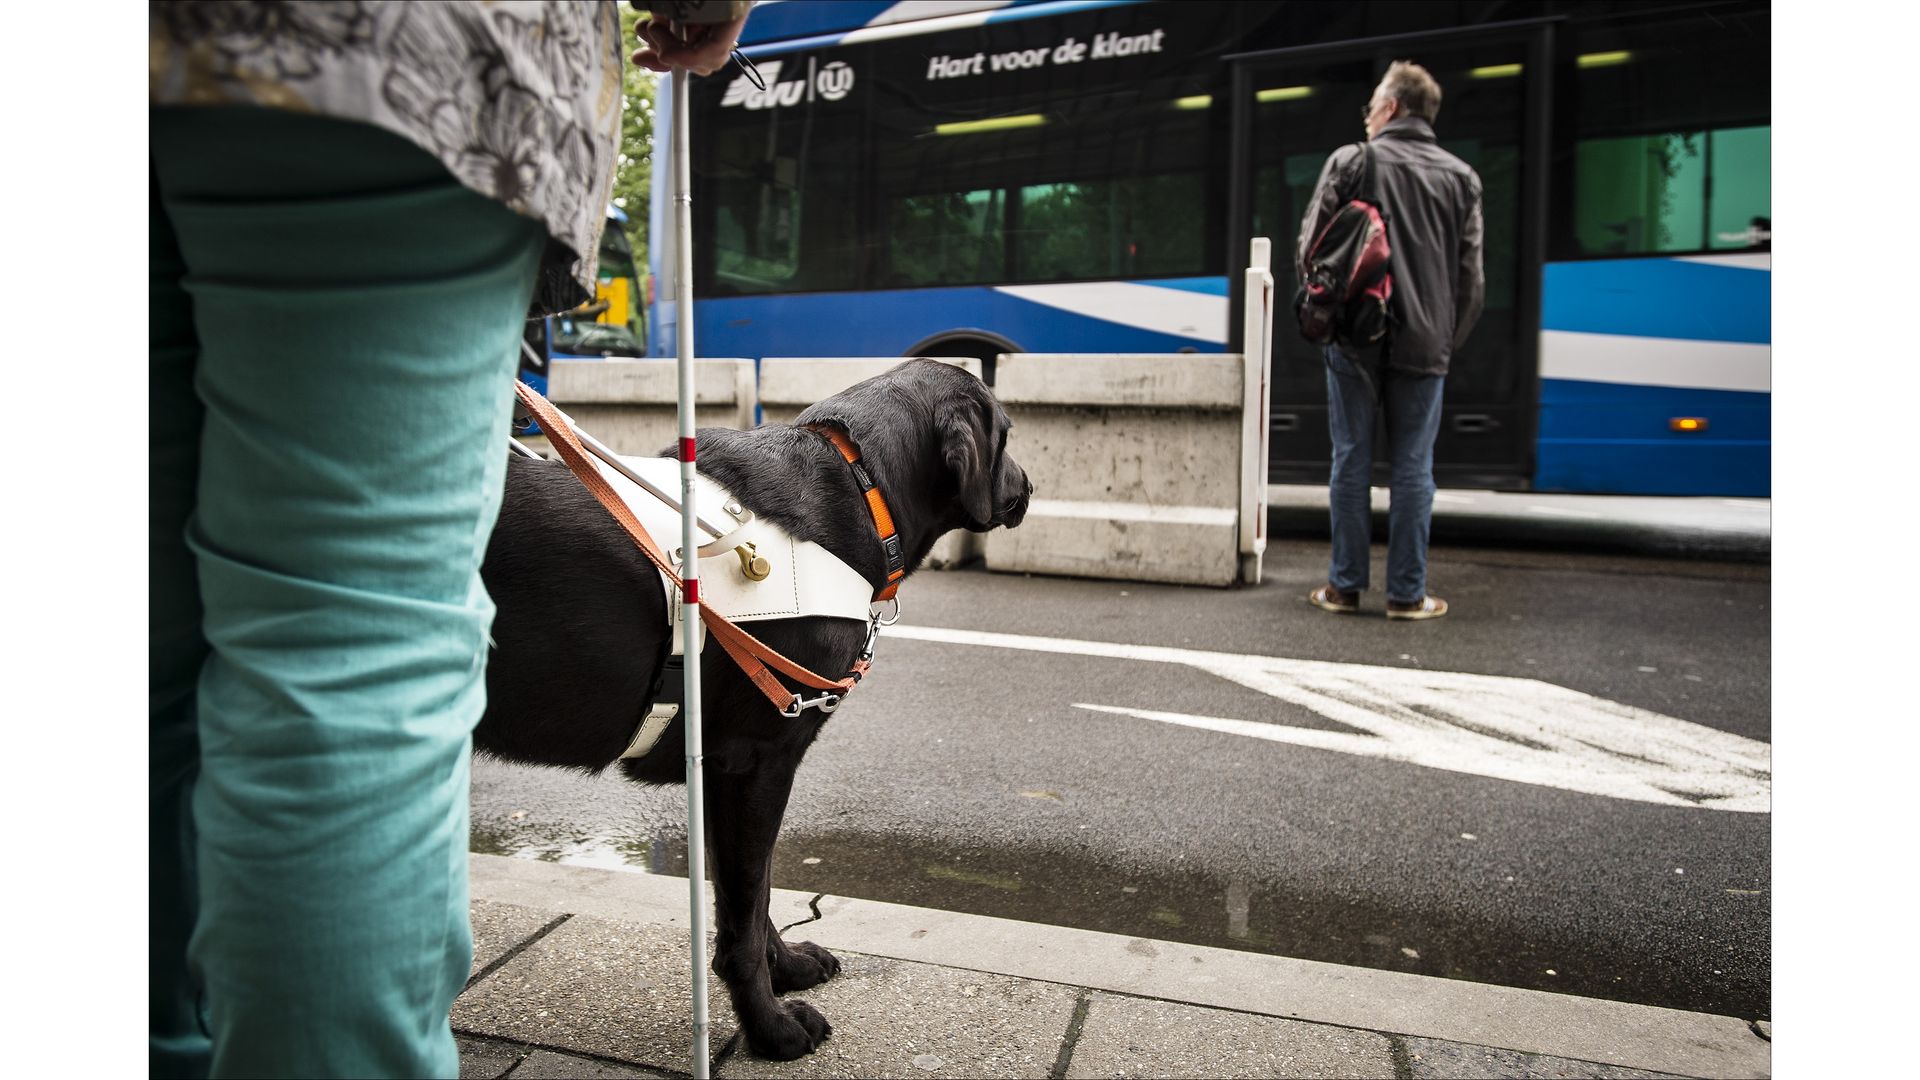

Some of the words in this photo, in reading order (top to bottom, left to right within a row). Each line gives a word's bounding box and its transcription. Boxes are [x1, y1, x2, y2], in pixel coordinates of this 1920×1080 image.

[926, 52, 985, 80] Hart
[990, 47, 1050, 71] voor
[1052, 38, 1087, 65] de
[1090, 28, 1165, 59] klant
[743, 79, 806, 110] GVU
